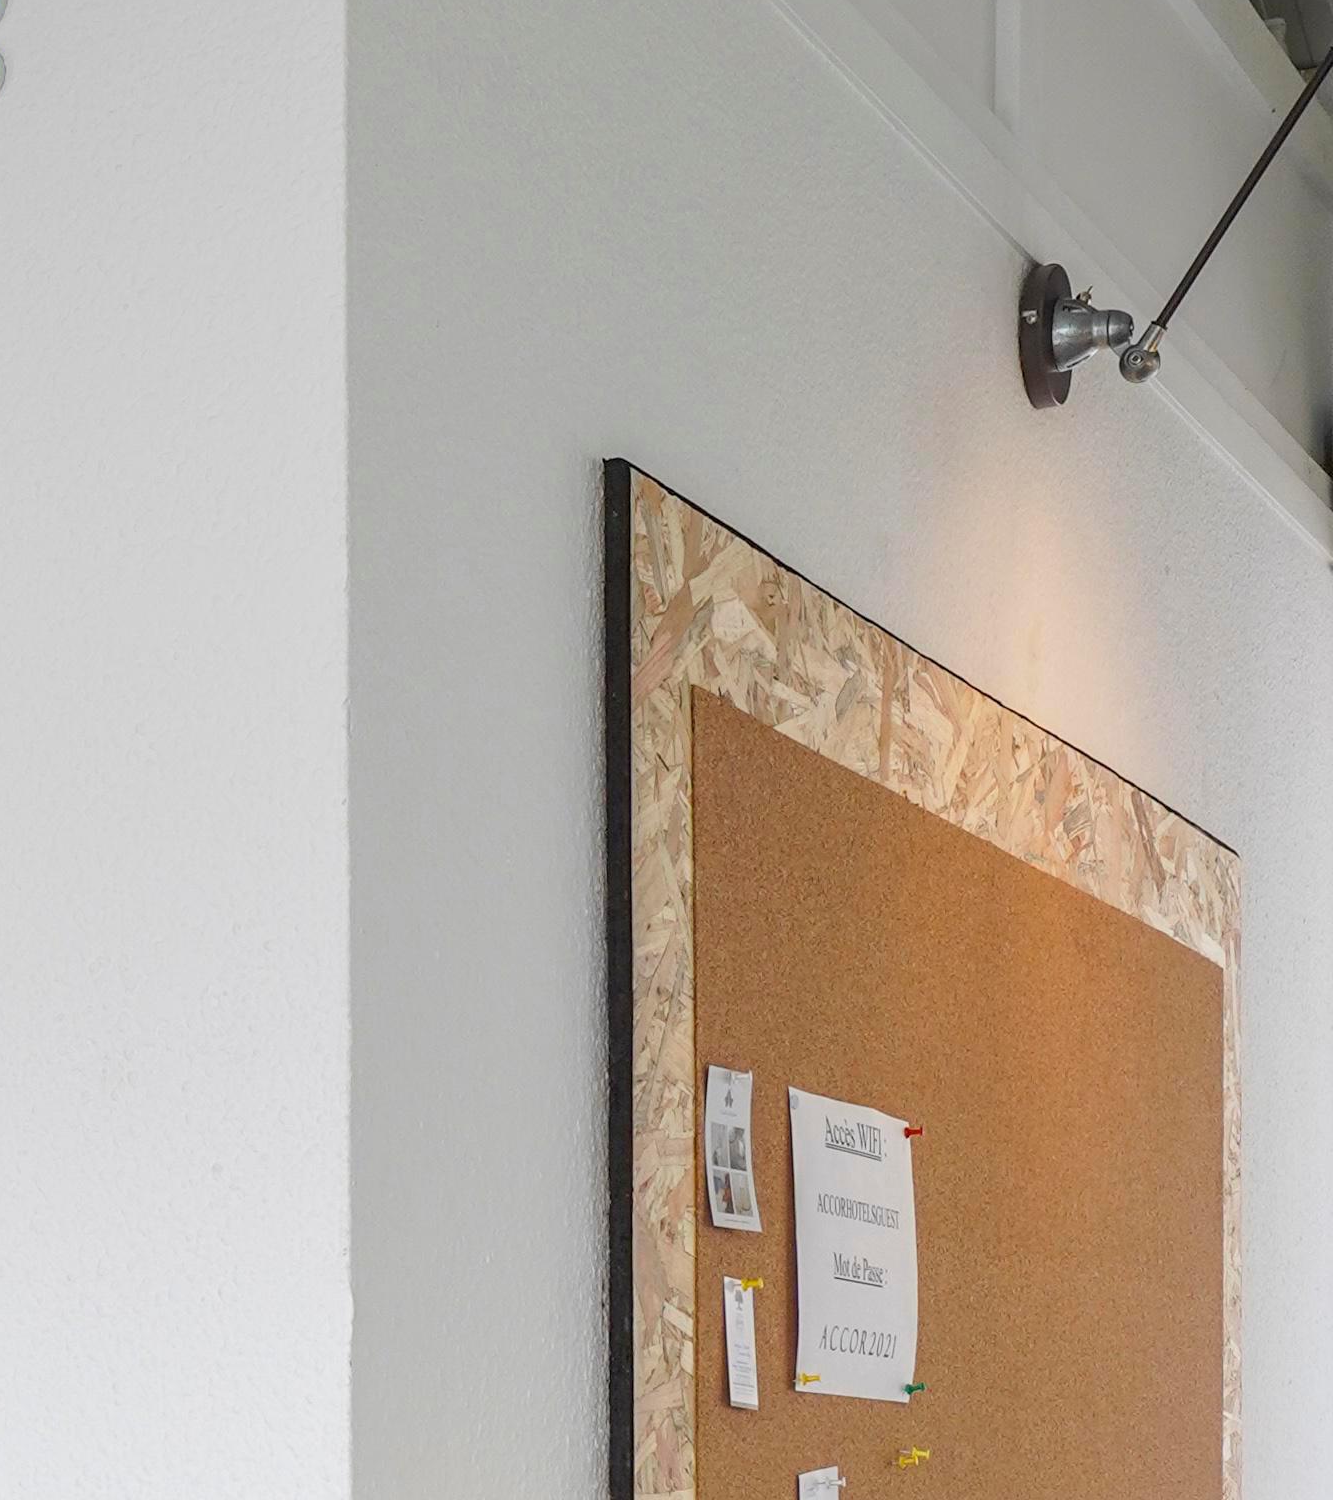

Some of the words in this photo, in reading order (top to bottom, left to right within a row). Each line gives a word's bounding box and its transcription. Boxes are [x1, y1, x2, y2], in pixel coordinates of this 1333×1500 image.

[824, 1115, 856, 1149] Accès
[856, 1122, 882, 1156] WIFI
[816, 1192, 900, 1230] ACCORHOTELSGUEST
[833, 1251, 851, 1278] Mot
[851, 1255, 861, 1280] de
[862, 1257, 884, 1285] Passe
[818, 1324, 898, 1360] ACCOR2021
